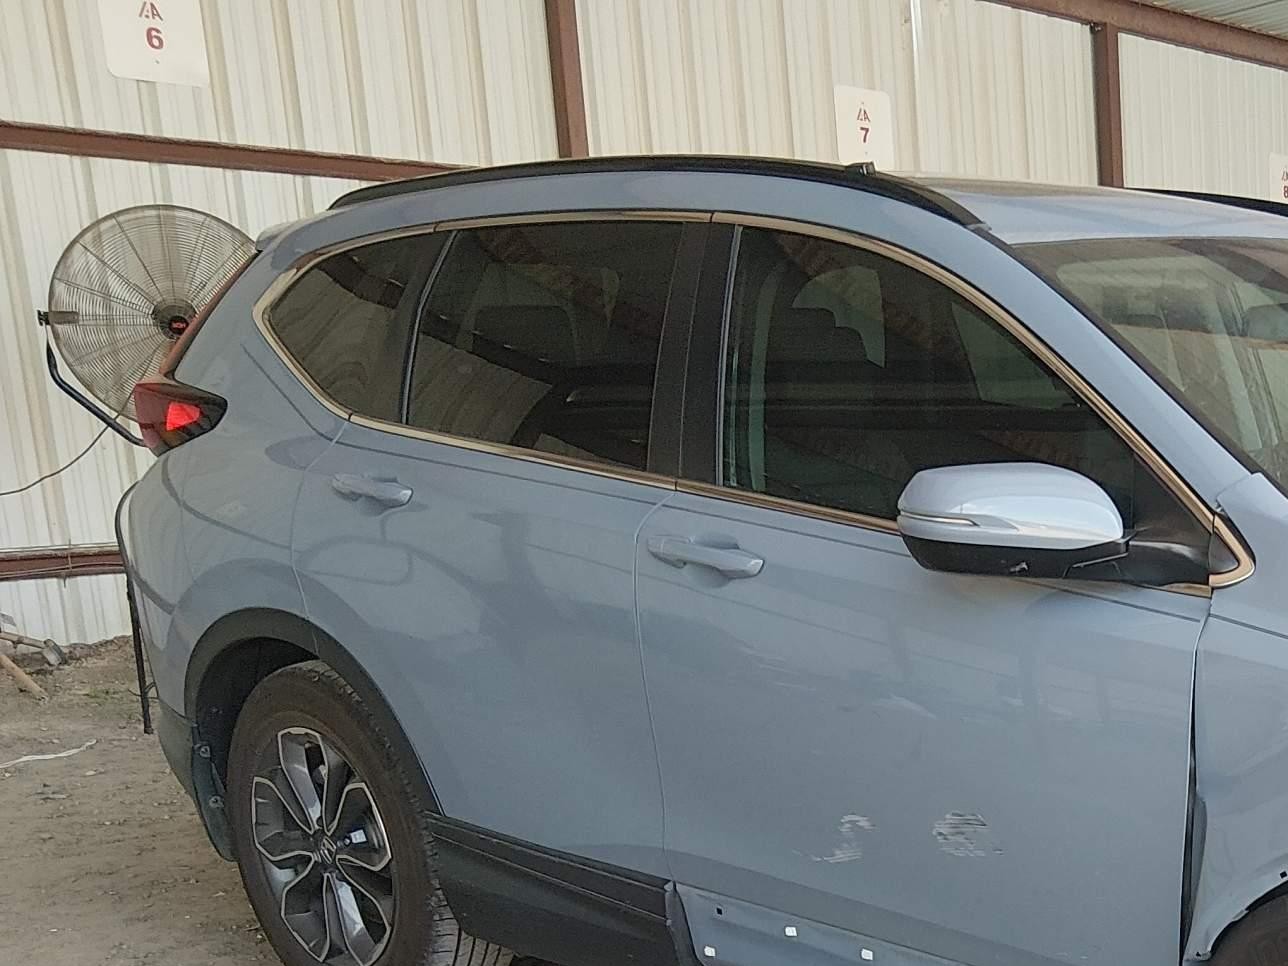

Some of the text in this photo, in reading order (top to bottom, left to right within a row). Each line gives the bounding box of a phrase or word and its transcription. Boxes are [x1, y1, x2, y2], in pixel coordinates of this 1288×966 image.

[146, 27, 164, 50] 6
[860, 126, 870, 143] 7
[1283, 185, 1288, 199] 8
